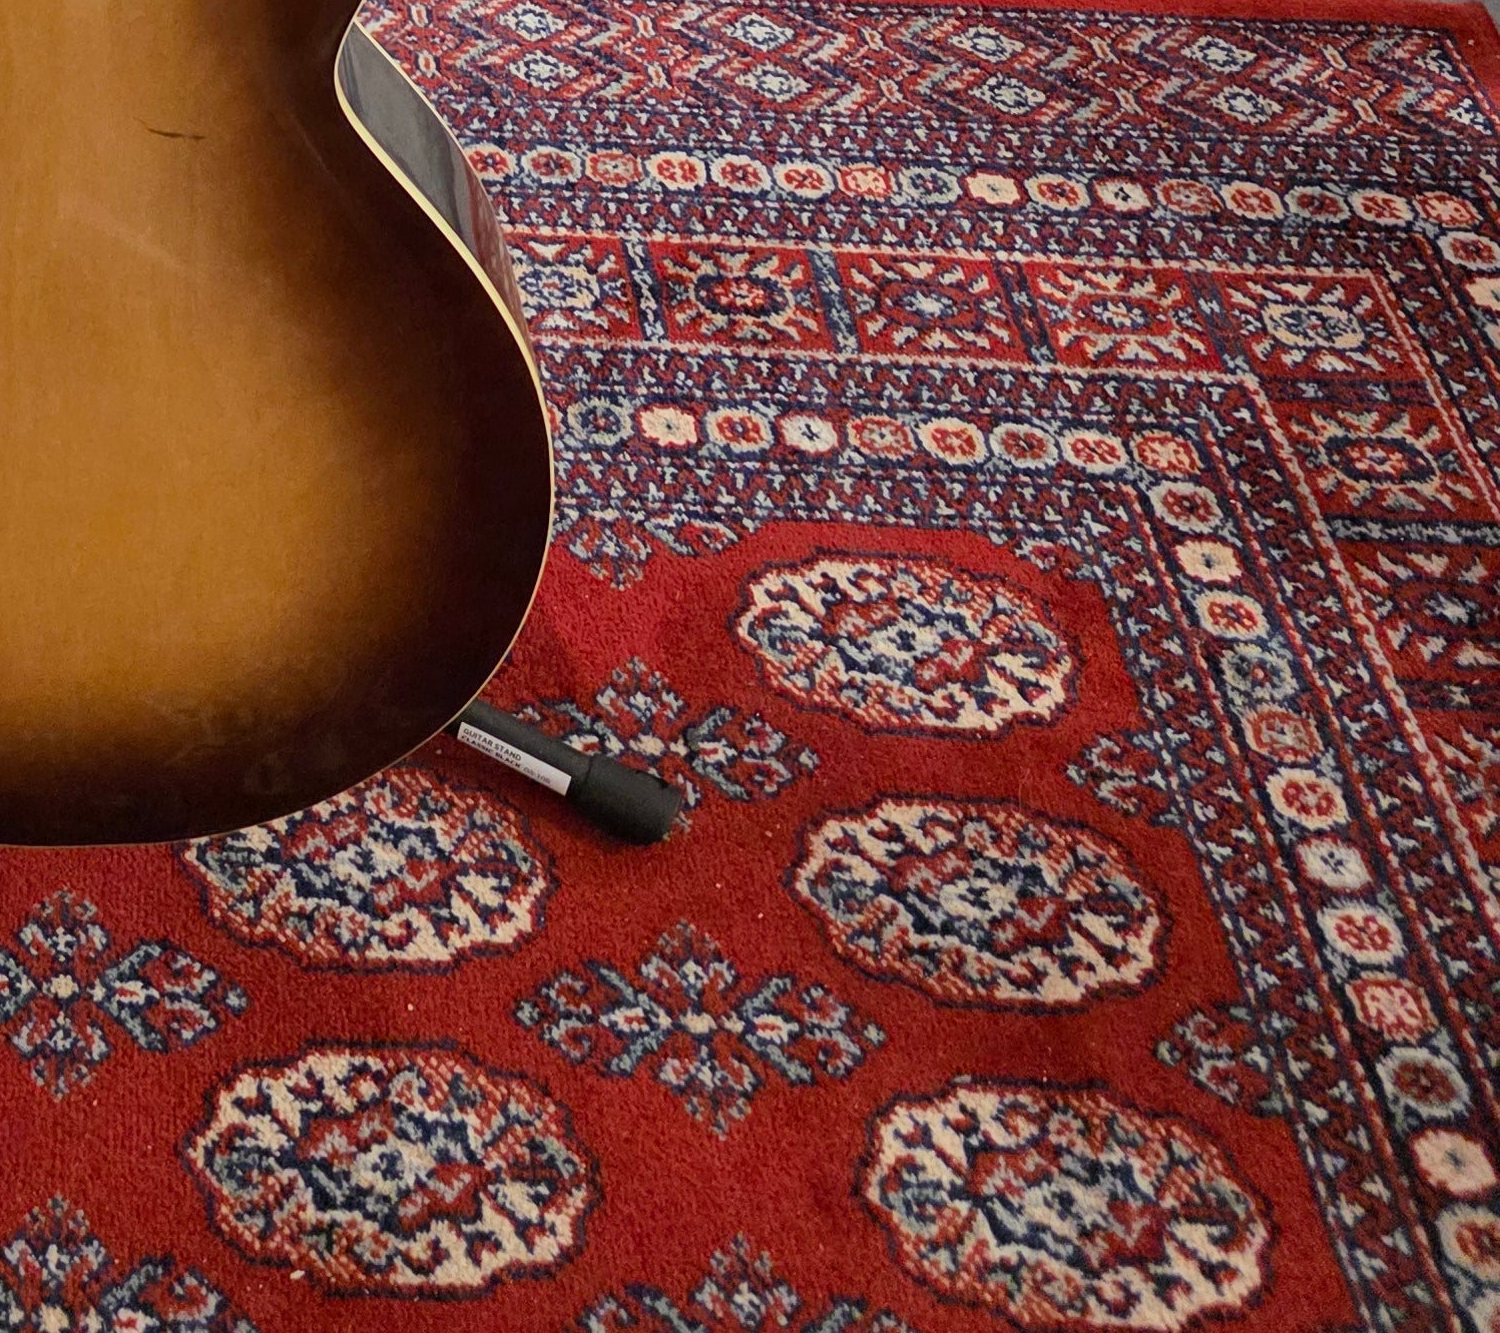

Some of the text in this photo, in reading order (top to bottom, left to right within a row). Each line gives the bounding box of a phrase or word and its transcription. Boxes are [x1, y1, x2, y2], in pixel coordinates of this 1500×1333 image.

[462, 728, 522, 762] GUITAR STAND
[494, 752, 521, 768] BLACK
